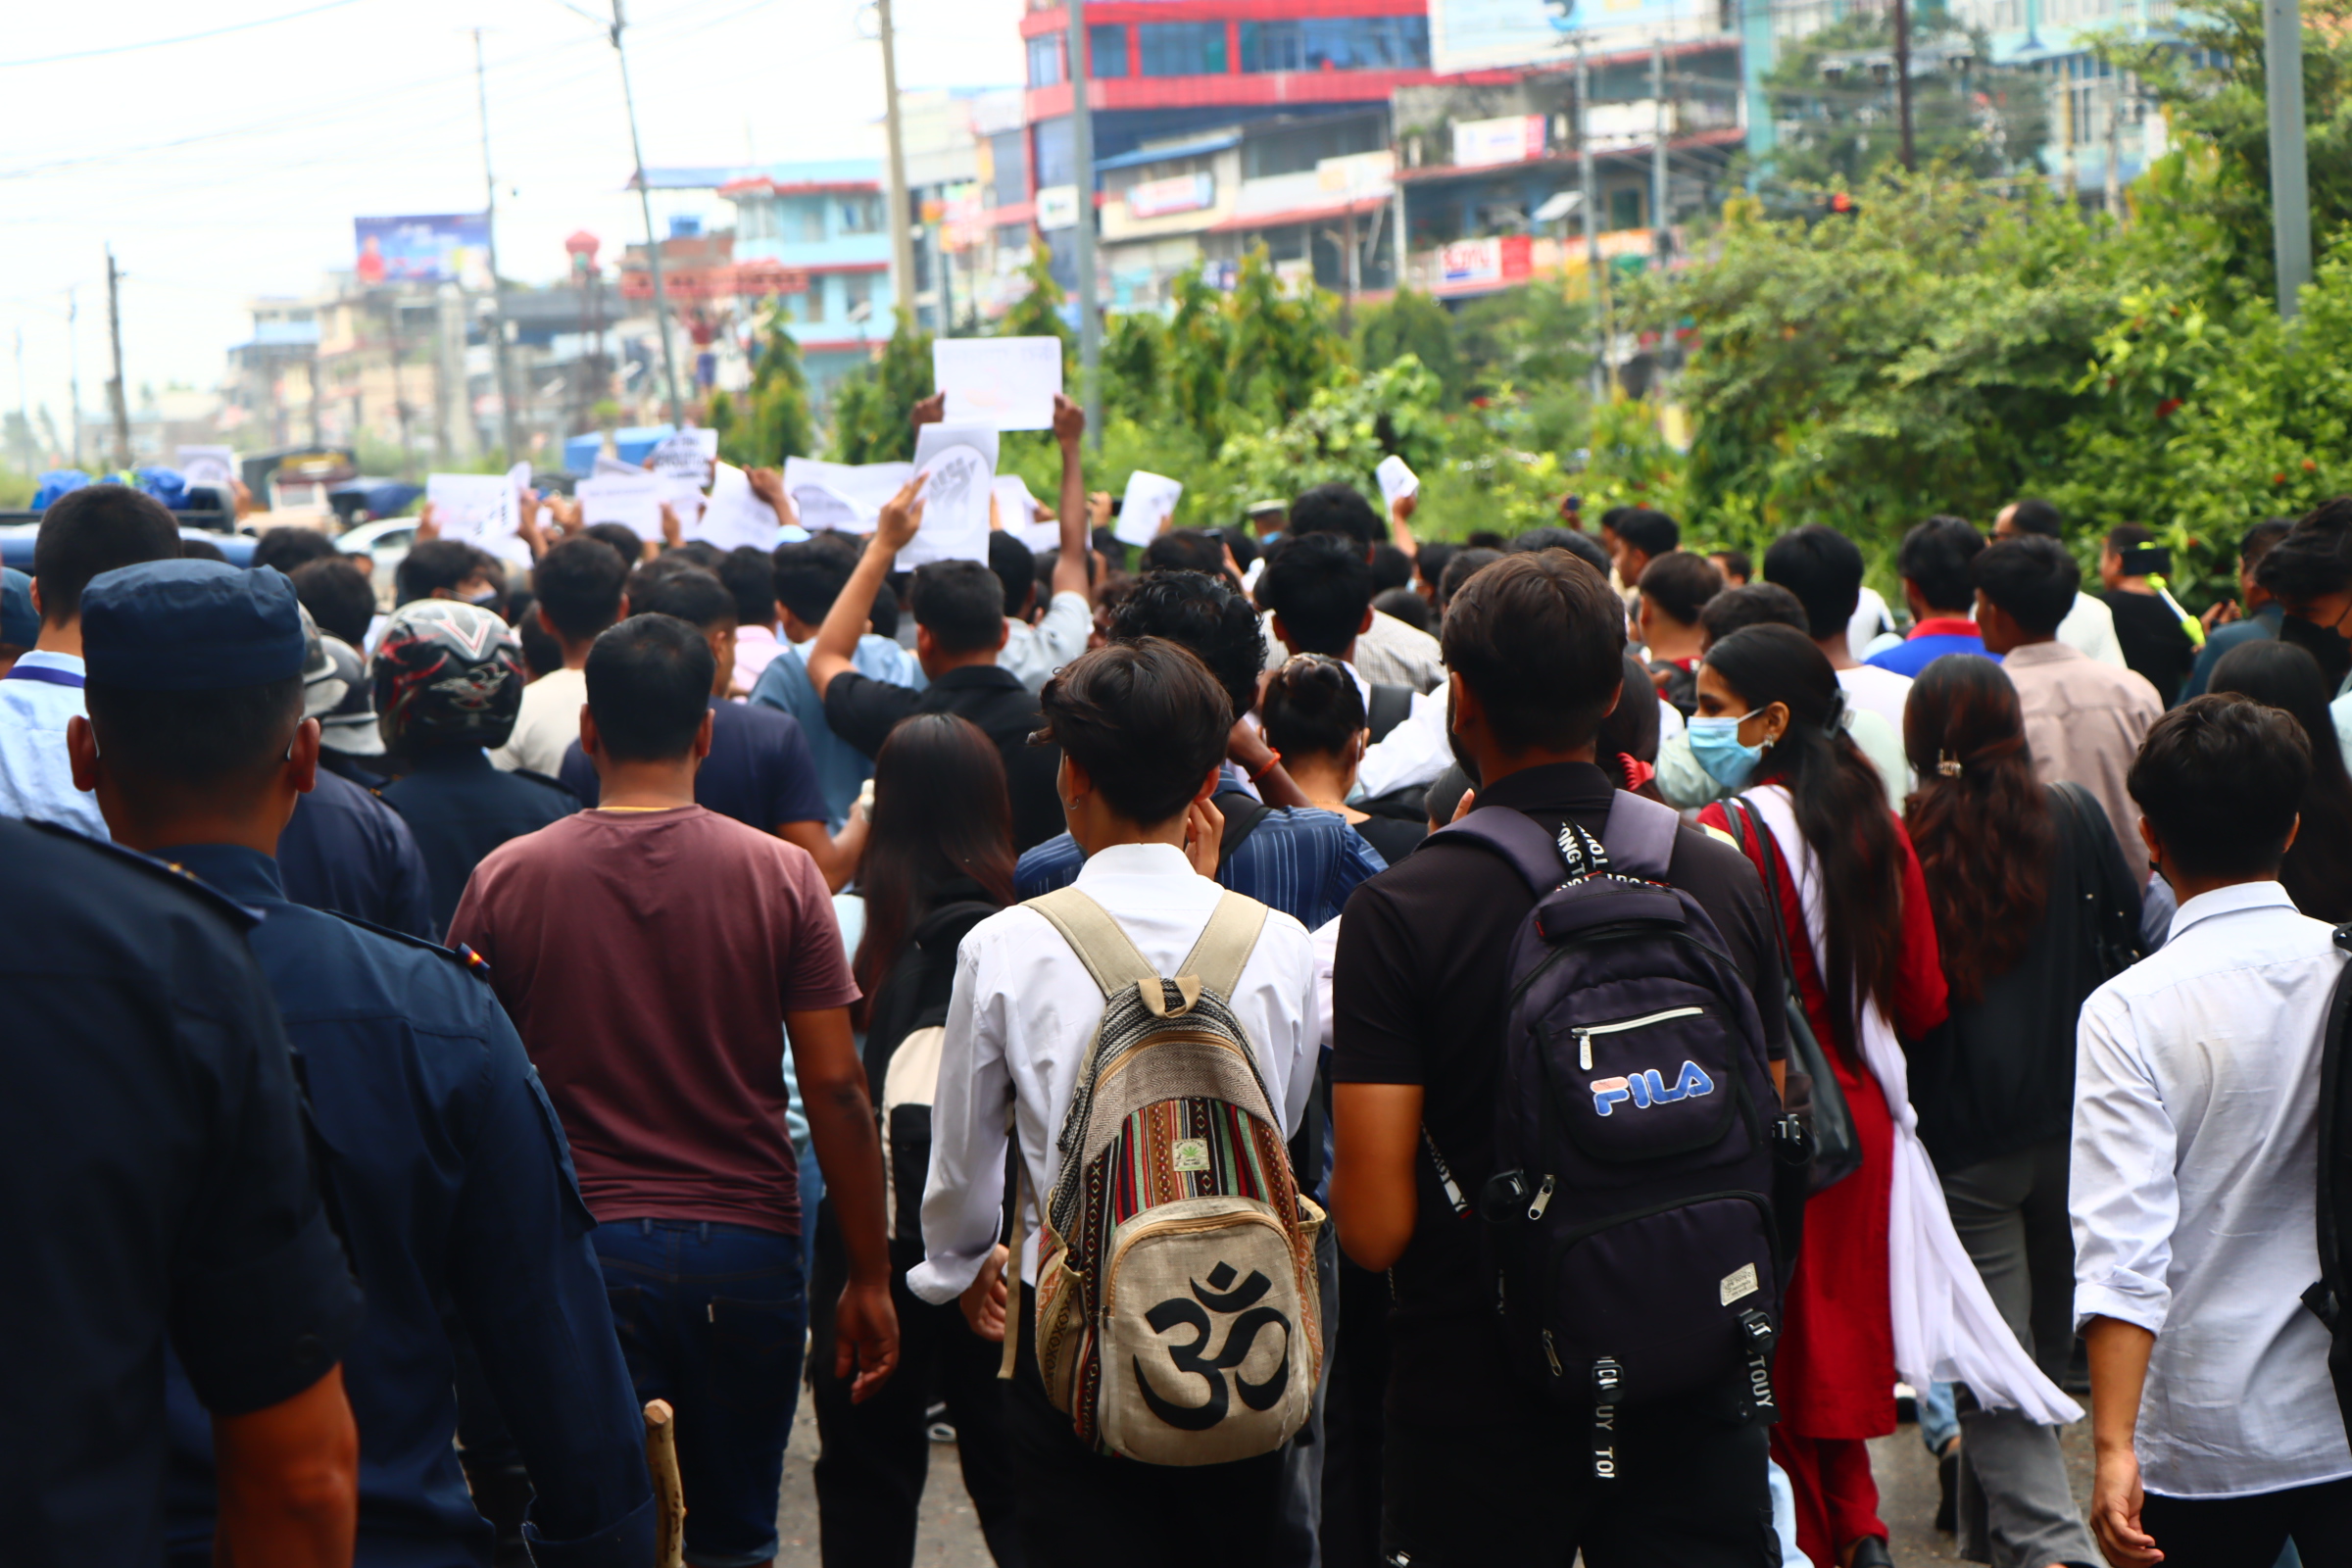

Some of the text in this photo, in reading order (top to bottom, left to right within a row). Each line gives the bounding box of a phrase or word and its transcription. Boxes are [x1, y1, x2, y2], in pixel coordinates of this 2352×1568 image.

[1556, 821, 1583, 864] ONG
[1590, 1059, 1714, 1117] FILA
[1748, 1354, 1775, 1407] TOUY
[1595, 1404, 1614, 1431] UY
